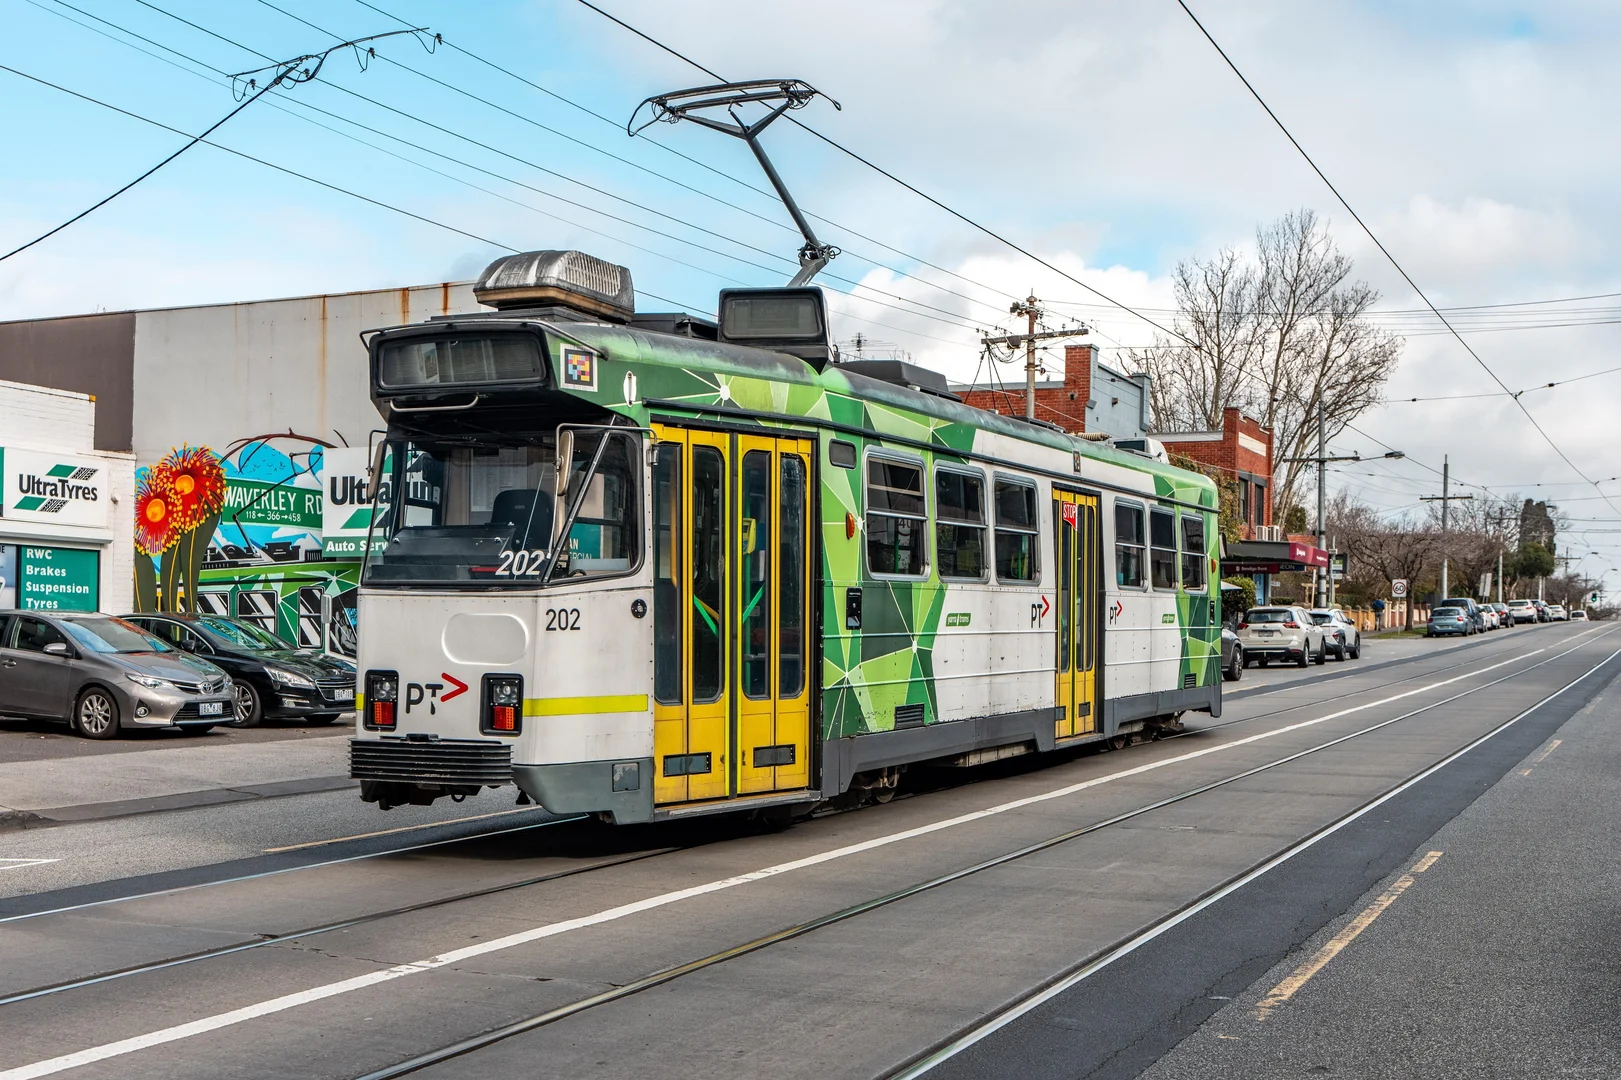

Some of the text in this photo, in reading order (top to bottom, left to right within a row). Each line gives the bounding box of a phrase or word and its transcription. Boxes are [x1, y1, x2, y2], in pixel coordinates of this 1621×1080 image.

[18, 474, 98, 502] UltraTyres
[224, 485, 323, 515] WAVERLEY RD
[245, 510, 302, 523] 118 366 458
[1063, 503, 1077, 519] STOP
[326, 540, 356, 552] Auto
[26, 548, 53, 560] RWC
[495, 550, 545, 576] 202
[26, 565, 67, 577] Brakes
[25, 581, 90, 595] Suspension
[25, 598, 59, 610] Tyres
[545, 608, 581, 631] 202
